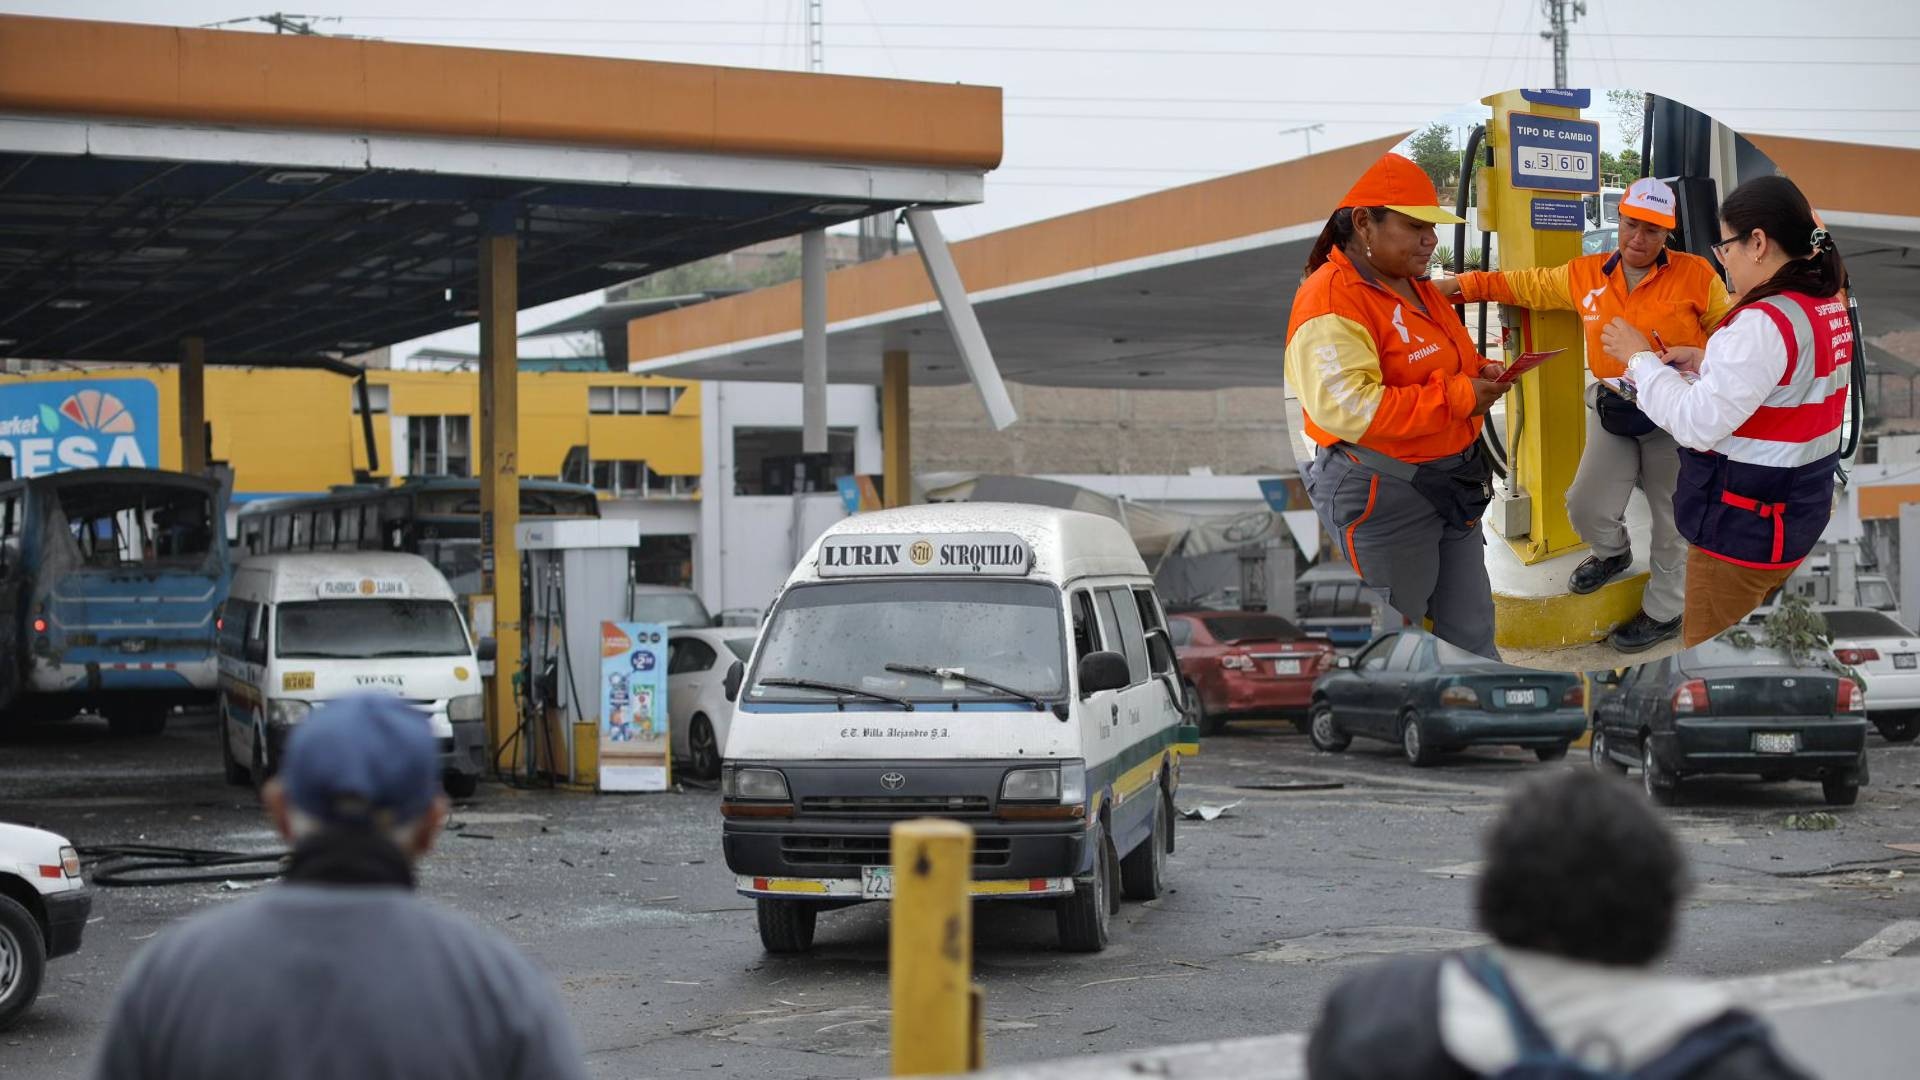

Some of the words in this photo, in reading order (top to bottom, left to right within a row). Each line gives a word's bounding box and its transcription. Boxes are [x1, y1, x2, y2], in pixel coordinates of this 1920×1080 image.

[1517, 126, 1539, 136] TIPO
[1543, 129, 1555, 138] DE
[1558, 131, 1593, 142] CAMBIO
[1408, 343, 1440, 364] PRIMAX
[825, 544, 902, 567] LURIN
[940, 544, 1023, 567] SURQUILLO
[886, 728, 928, 739] Alejandro
